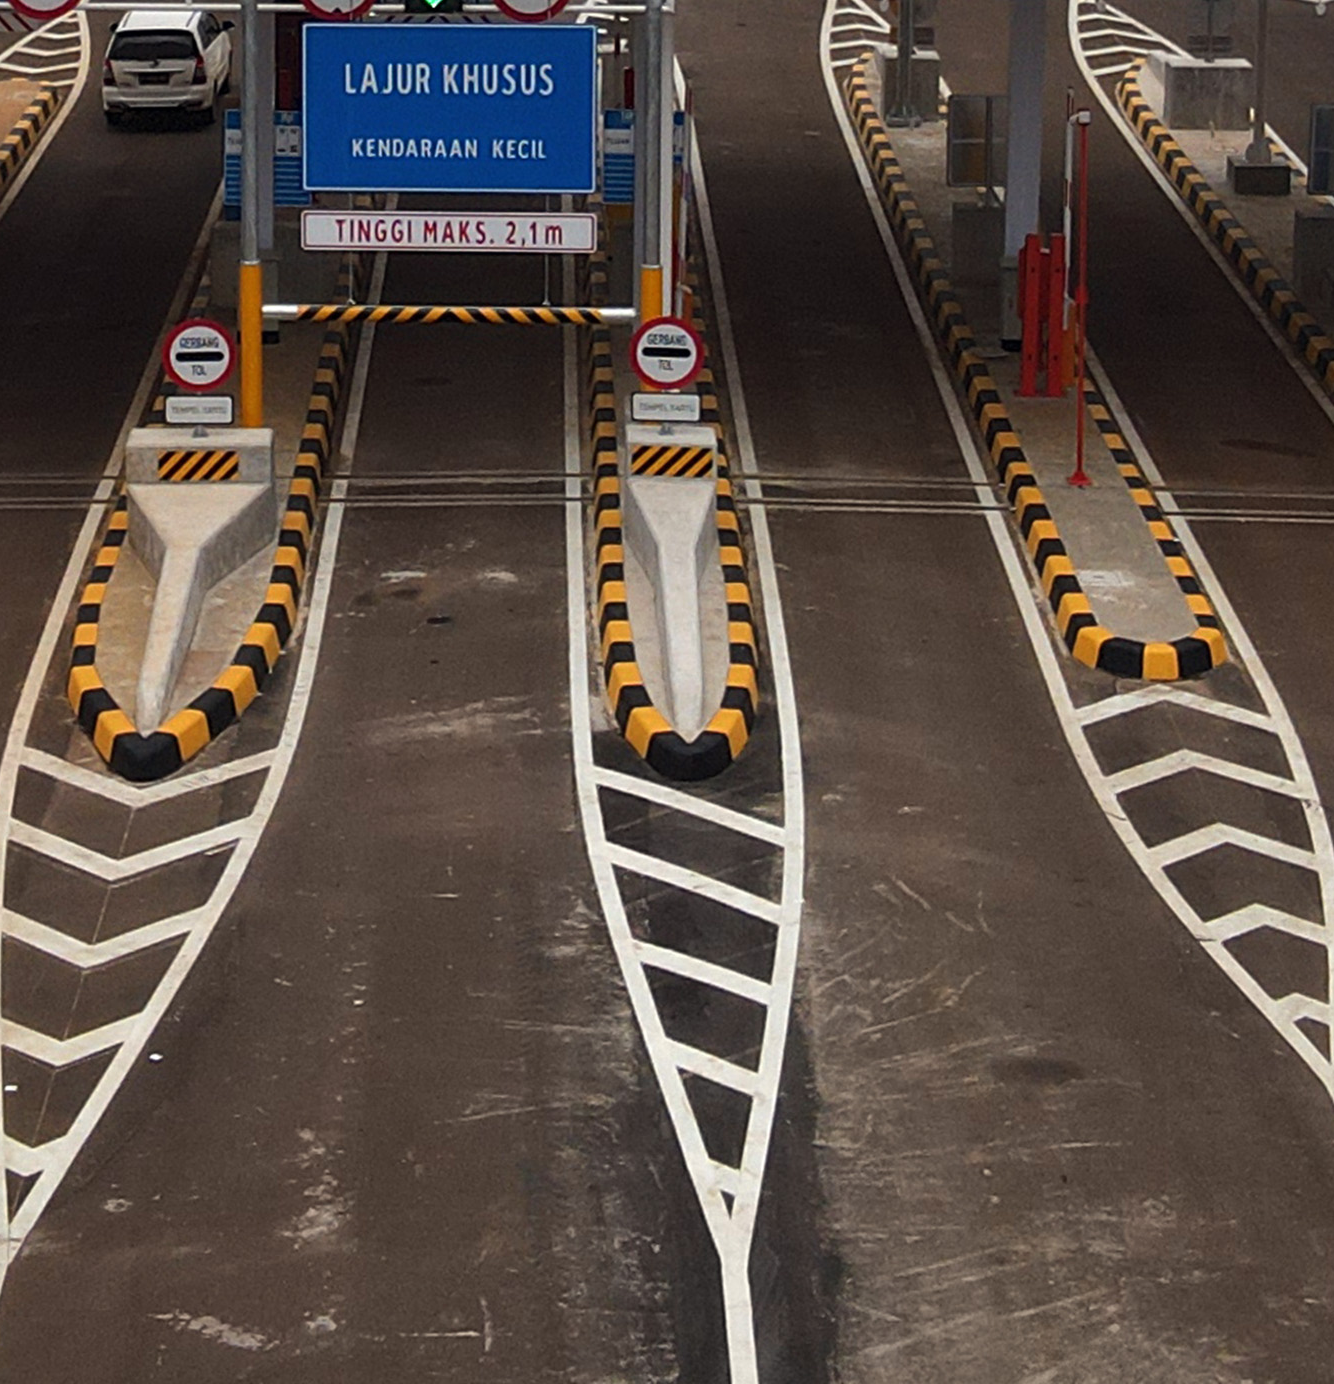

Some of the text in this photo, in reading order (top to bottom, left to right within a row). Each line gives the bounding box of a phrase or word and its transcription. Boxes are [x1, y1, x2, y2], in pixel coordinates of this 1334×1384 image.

[344, 63, 555, 96] LAJUR KHUSUS
[351, 138, 547, 160] KENDARAAN KECIL
[335, 218, 413, 244] TINGGI
[423, 220, 495, 245] MAKS.
[179, 336, 220, 349] GERBANG
[646, 333, 687, 346] GERBANG
[190, 364, 206, 376] TOL
[658, 359, 674, 371] TOL
